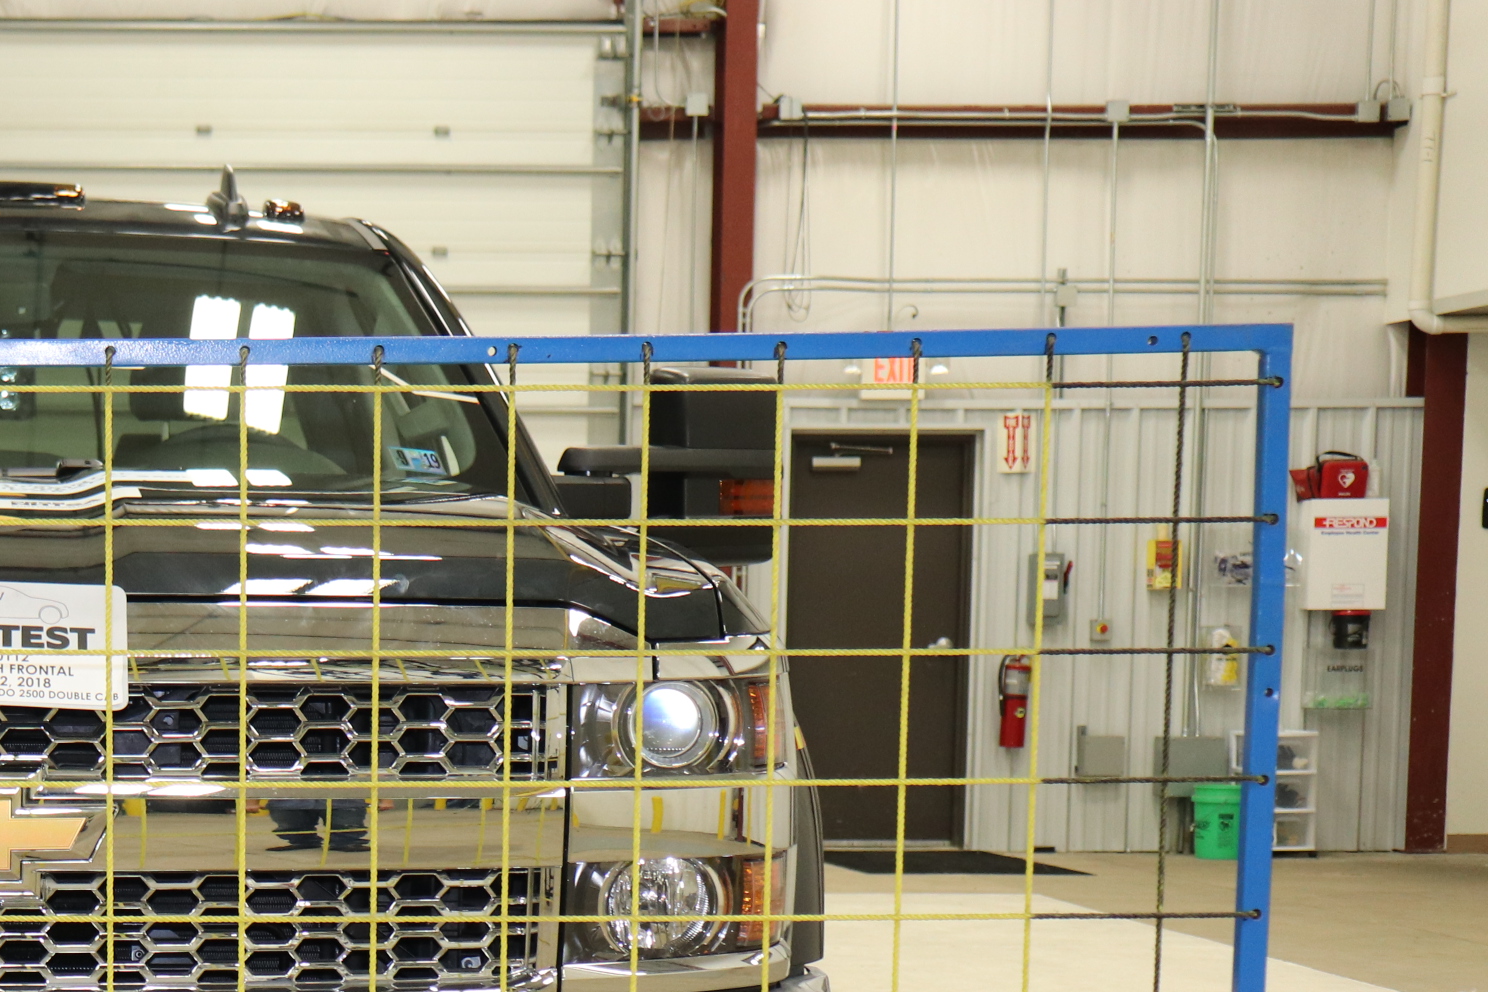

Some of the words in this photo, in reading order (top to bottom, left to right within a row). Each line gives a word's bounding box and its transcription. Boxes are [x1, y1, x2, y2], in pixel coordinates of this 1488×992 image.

[424, 452, 442, 469] 19
[10, 664, 74, 676] FRONTAL
[0, 676, 11, 687] 2,
[17, 677, 52, 688] 2018
[19, 689, 46, 699] 2500
[49, 691, 91, 701] DOUBLE
[95, 692, 119, 701] CB
